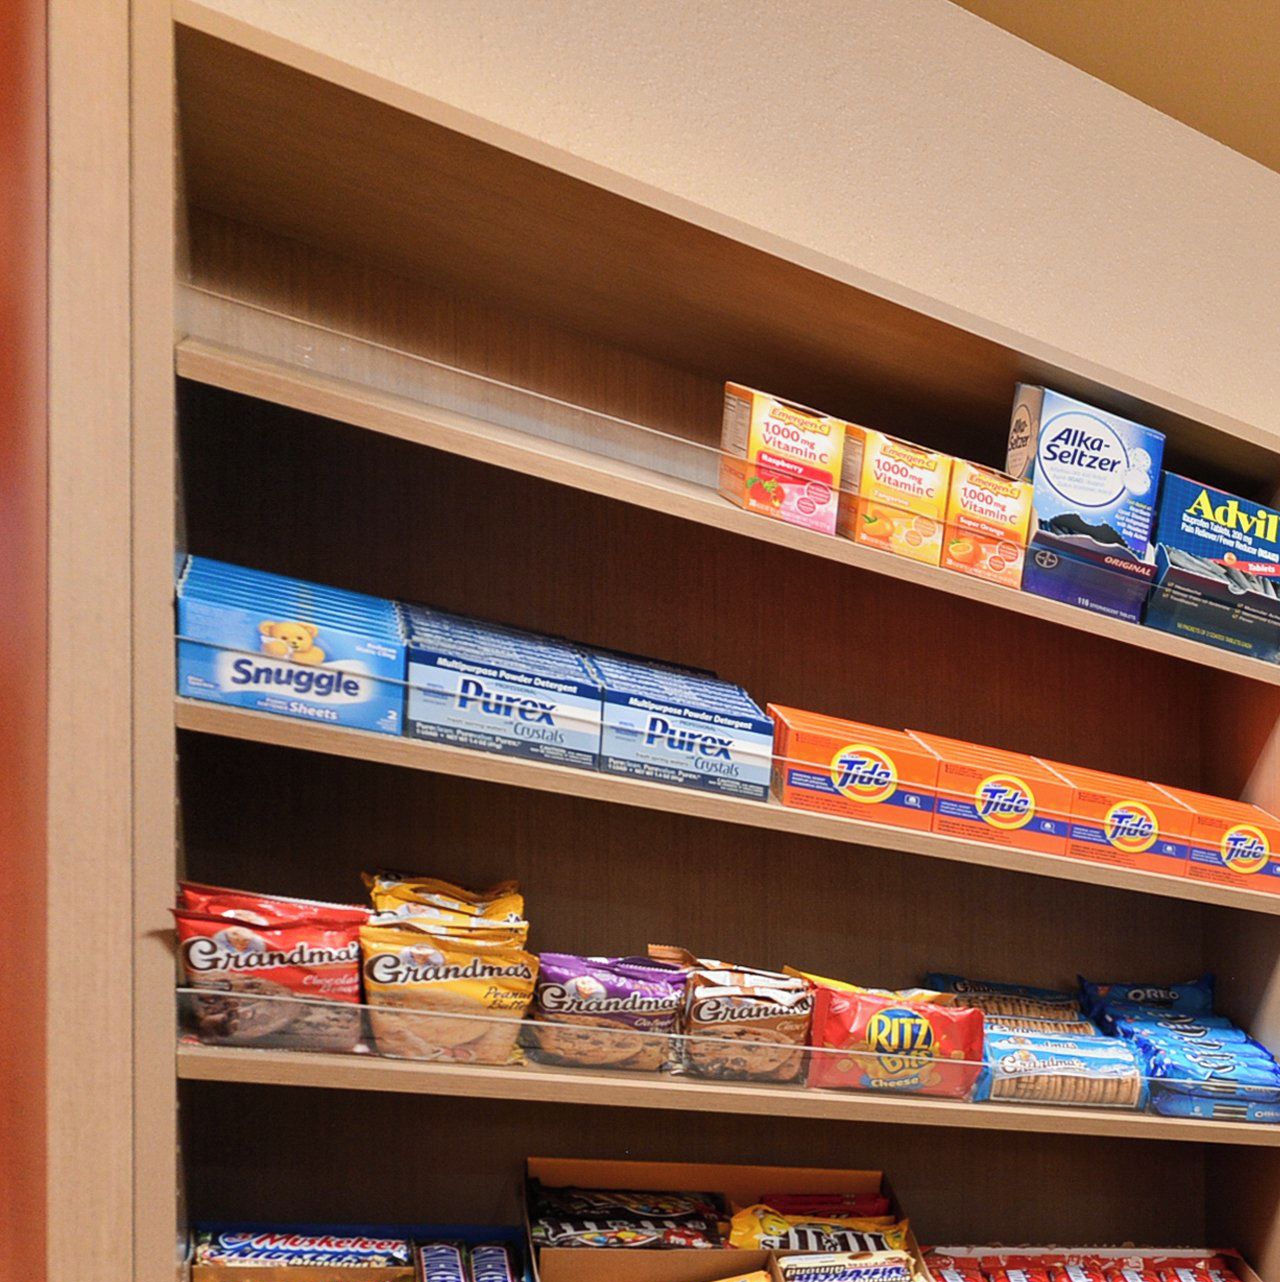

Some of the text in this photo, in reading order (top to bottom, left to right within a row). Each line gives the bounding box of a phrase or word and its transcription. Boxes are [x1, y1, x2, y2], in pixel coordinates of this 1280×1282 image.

[764, 421, 815, 449] 1,000 mg
[1050, 427, 1111, 452] Alka-
[761, 453, 804, 474] Raspberry
[762, 434, 829, 465] Vitamin C
[1043, 443, 1121, 473] Seltzer
[873, 470, 935, 498] Vitamin C
[874, 458, 923, 484] 1,000 mg
[960, 498, 1008, 522] Vitamin
[1185, 488, 1280, 544] Advil
[1104, 554, 1151, 577] ORIGINAL
[231, 658, 360, 697] Snuggle
[437, 657, 578, 695] Multipurpose Powder Detergent
[289, 701, 338, 720] Sheets
[455, 676, 556, 727] Purex
[628, 697, 753, 730] Multipurpose Powder Detergent
[513, 721, 564, 744] Crystals
[647, 716, 734, 761] Purex
[695, 757, 739, 777] Crystals
[838, 758, 891, 788] Tide
[981, 787, 1030, 815] Tide
[1109, 813, 1153, 840] Tide
[1226, 837, 1265, 861] Tide
[182, 937, 361, 973] Grandma's
[364, 952, 535, 985] Grandma's
[1127, 984, 1181, 1003] OREO
[868, 1014, 931, 1050] RITZ
[870, 1076, 920, 1088] Cheese
